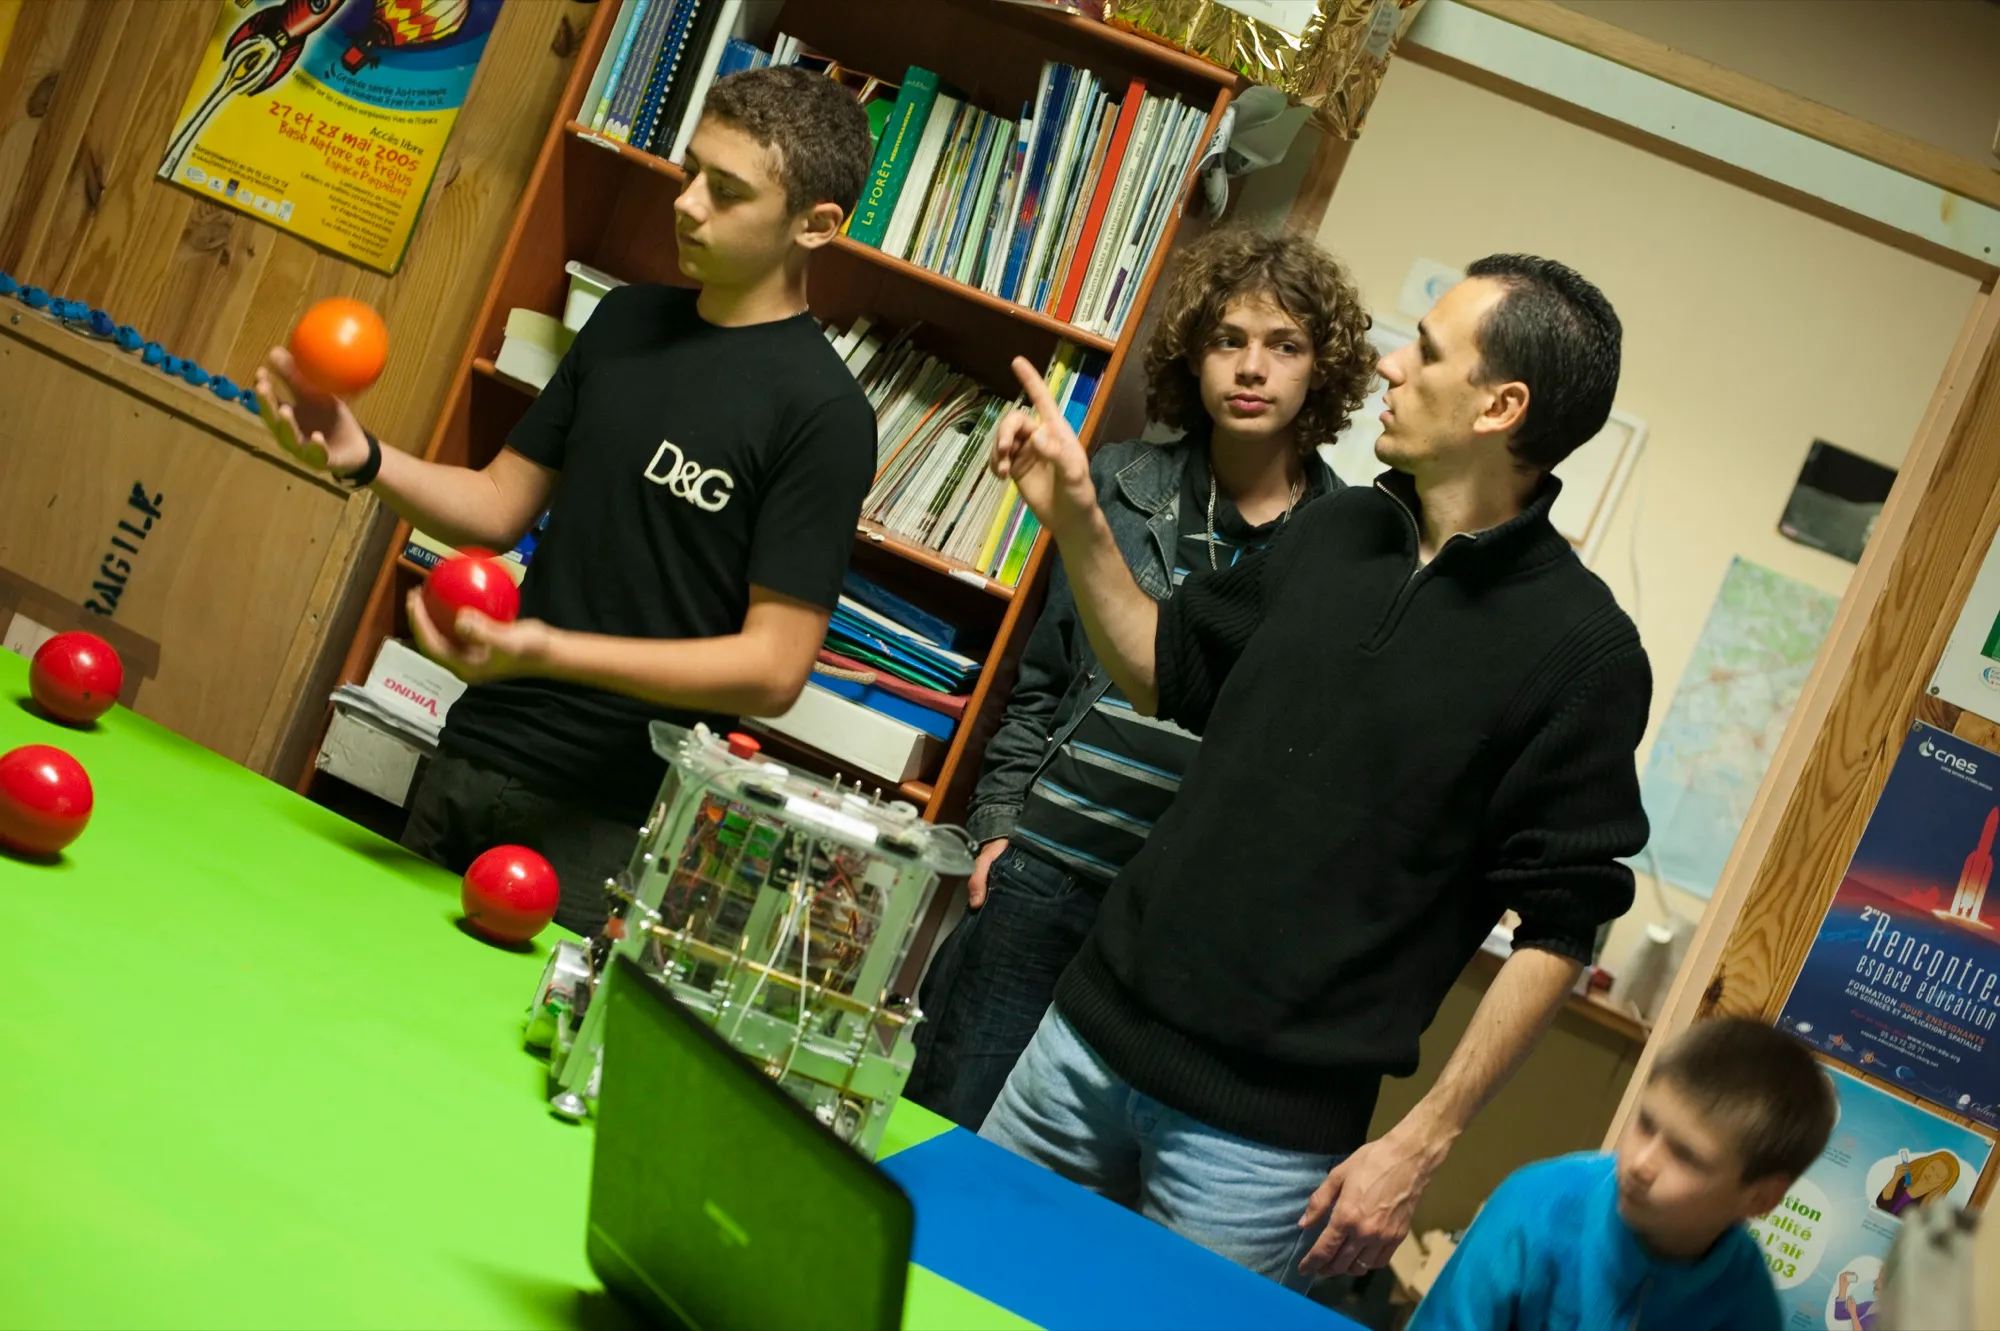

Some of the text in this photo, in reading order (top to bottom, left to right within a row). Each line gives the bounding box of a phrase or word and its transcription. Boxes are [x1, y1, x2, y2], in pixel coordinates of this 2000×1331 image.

[269, 100, 420, 172] 27 et 28 mai 2005
[278, 120, 307, 144] Base
[309, 135, 353, 162] Nature
[355, 154, 370, 169] de
[400, 138, 425, 156] libre
[325, 156, 357, 179] Espace
[861, 211, 875, 226] La
[868, 160, 892, 207] FORÊT
[643, 439, 735, 513] D&G
[383, 677, 439, 717] VIKING
[1934, 748, 1978, 776] cnes
[1848, 979, 1897, 1006] FORMATION
[1900, 1002, 1923, 1018] POUR
[1926, 1013, 1986, 1045] ENSEIGNANTS
[1856, 954, 1912, 993] espace
[1916, 976, 1997, 1031] éducation
[1845, 987, 1859, 998] AUX
[1860, 993, 1891, 1012] SCIENCES
[1892, 1007, 1901, 1016] ET
[1902, 1013, 1947, 1037] APPLICATIONS
[1948, 1032, 1983, 1053] SPATIALES
[1761, 1211, 1812, 1241] alité
[1781, 1195, 1822, 1222] tion
[1766, 1231, 1804, 1260] l'air
